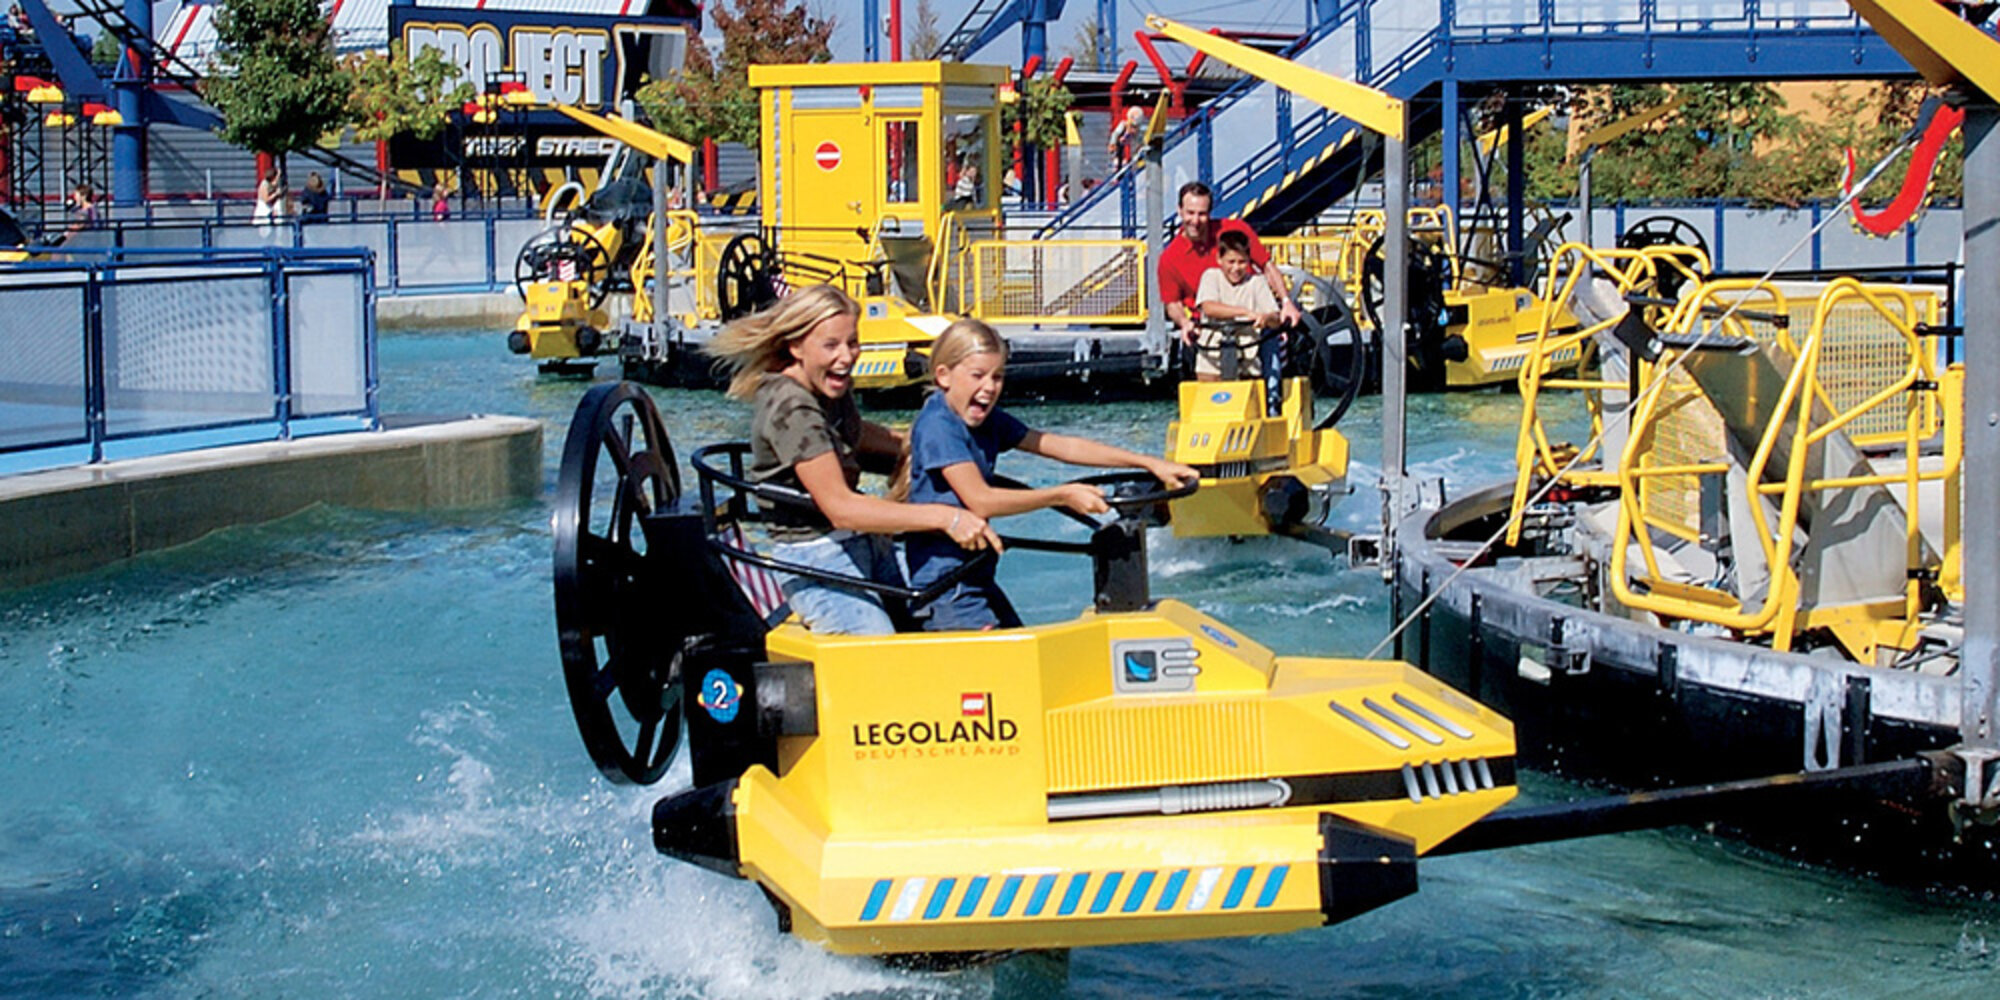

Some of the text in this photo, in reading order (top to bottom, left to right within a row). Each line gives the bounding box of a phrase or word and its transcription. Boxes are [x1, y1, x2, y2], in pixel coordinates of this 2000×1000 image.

[536, 136, 618, 157] STREC
[713, 680, 728, 709] 2
[853, 692, 1018, 746] LEGOLAND
[854, 745, 1021, 761] DEUTSCHLAND
